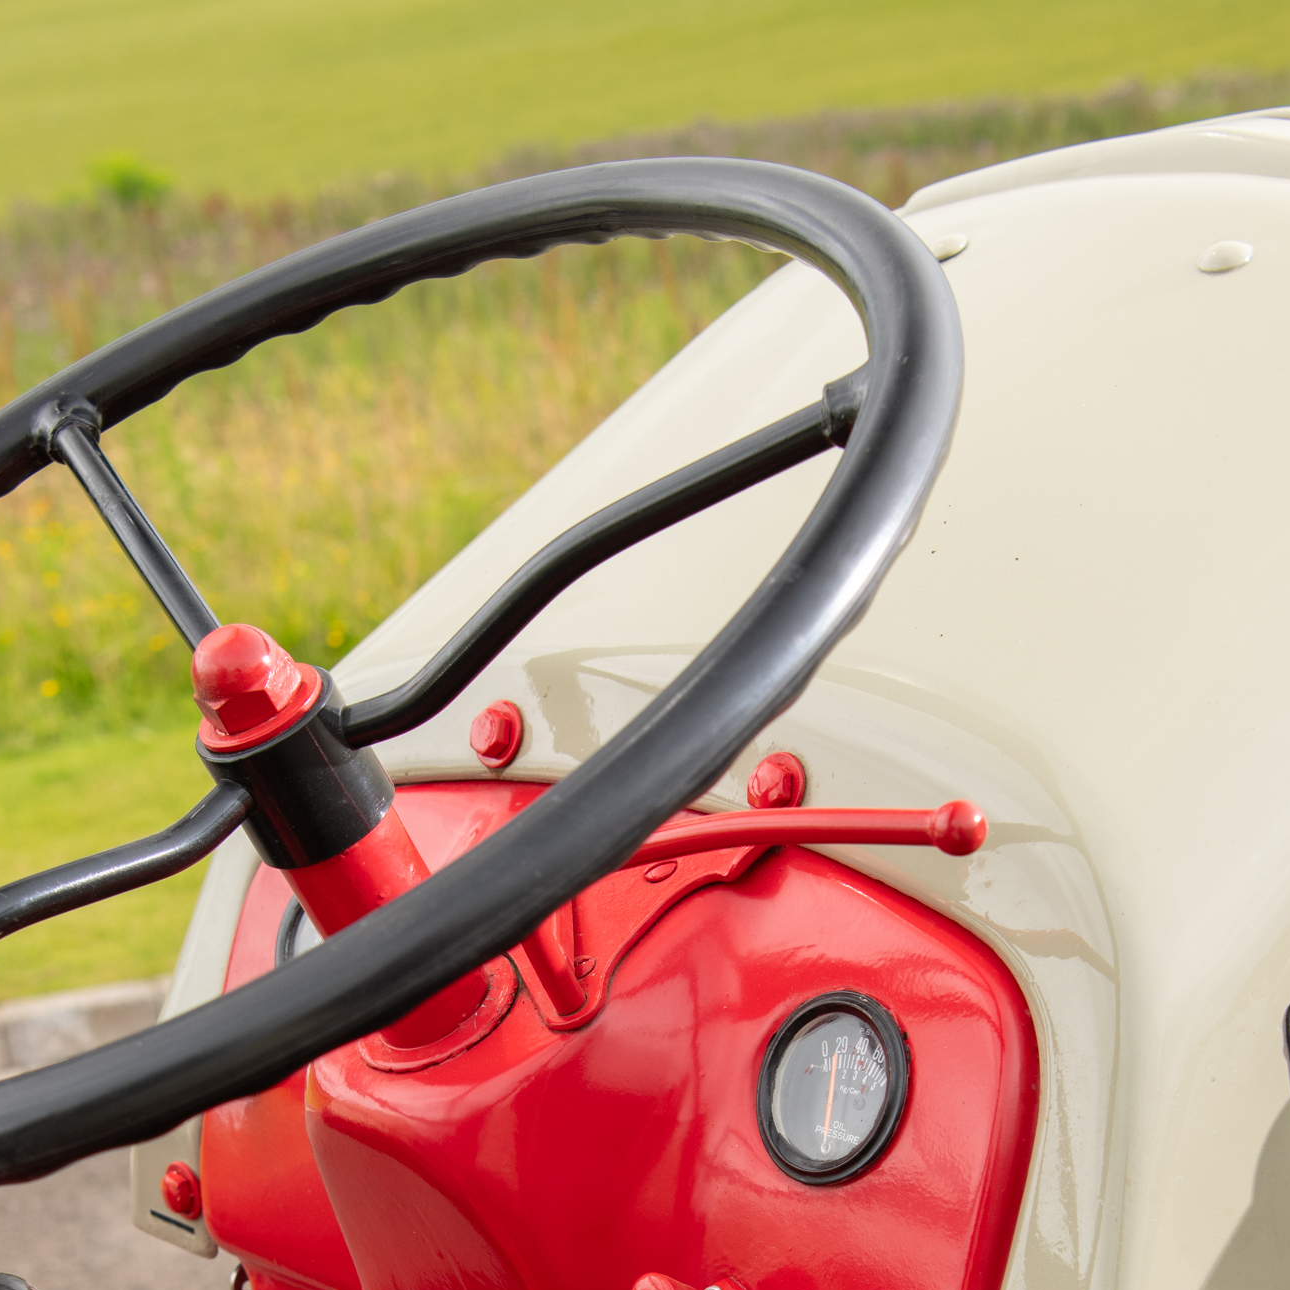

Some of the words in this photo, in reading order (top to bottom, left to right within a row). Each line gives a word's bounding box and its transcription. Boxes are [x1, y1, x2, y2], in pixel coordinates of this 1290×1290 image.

[821, 1040, 828, 1057] 0
[835, 1036, 848, 1054] 20
[855, 1037, 870, 1055] 40
[872, 1043, 885, 1064] 60
[842, 1069, 847, 1080] 2
[852, 1070, 858, 1081] 3
[862, 1075, 868, 1085] 4
[870, 1081, 877, 1091] 5
[832, 1120, 846, 1132] OIL
[815, 1124, 860, 1145] PRESSURE
